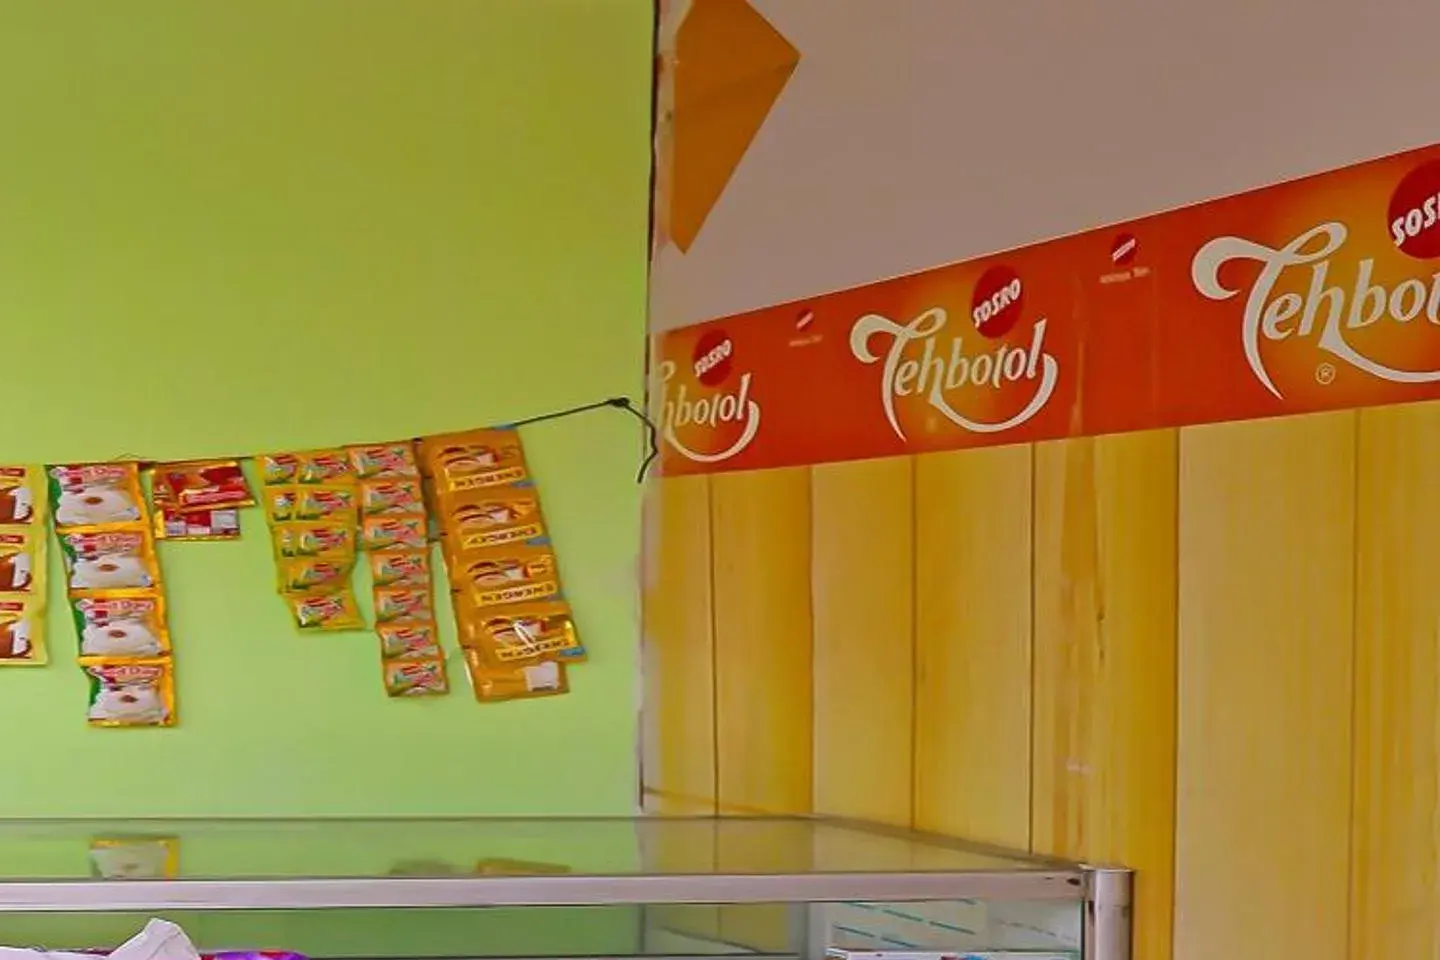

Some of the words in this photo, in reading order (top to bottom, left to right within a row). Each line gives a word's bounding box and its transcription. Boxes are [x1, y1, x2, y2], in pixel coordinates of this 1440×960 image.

[1392, 193, 1440, 247] SOS
[973, 278, 1022, 328] SOSRO
[850, 307, 1058, 443] Tehbotol
